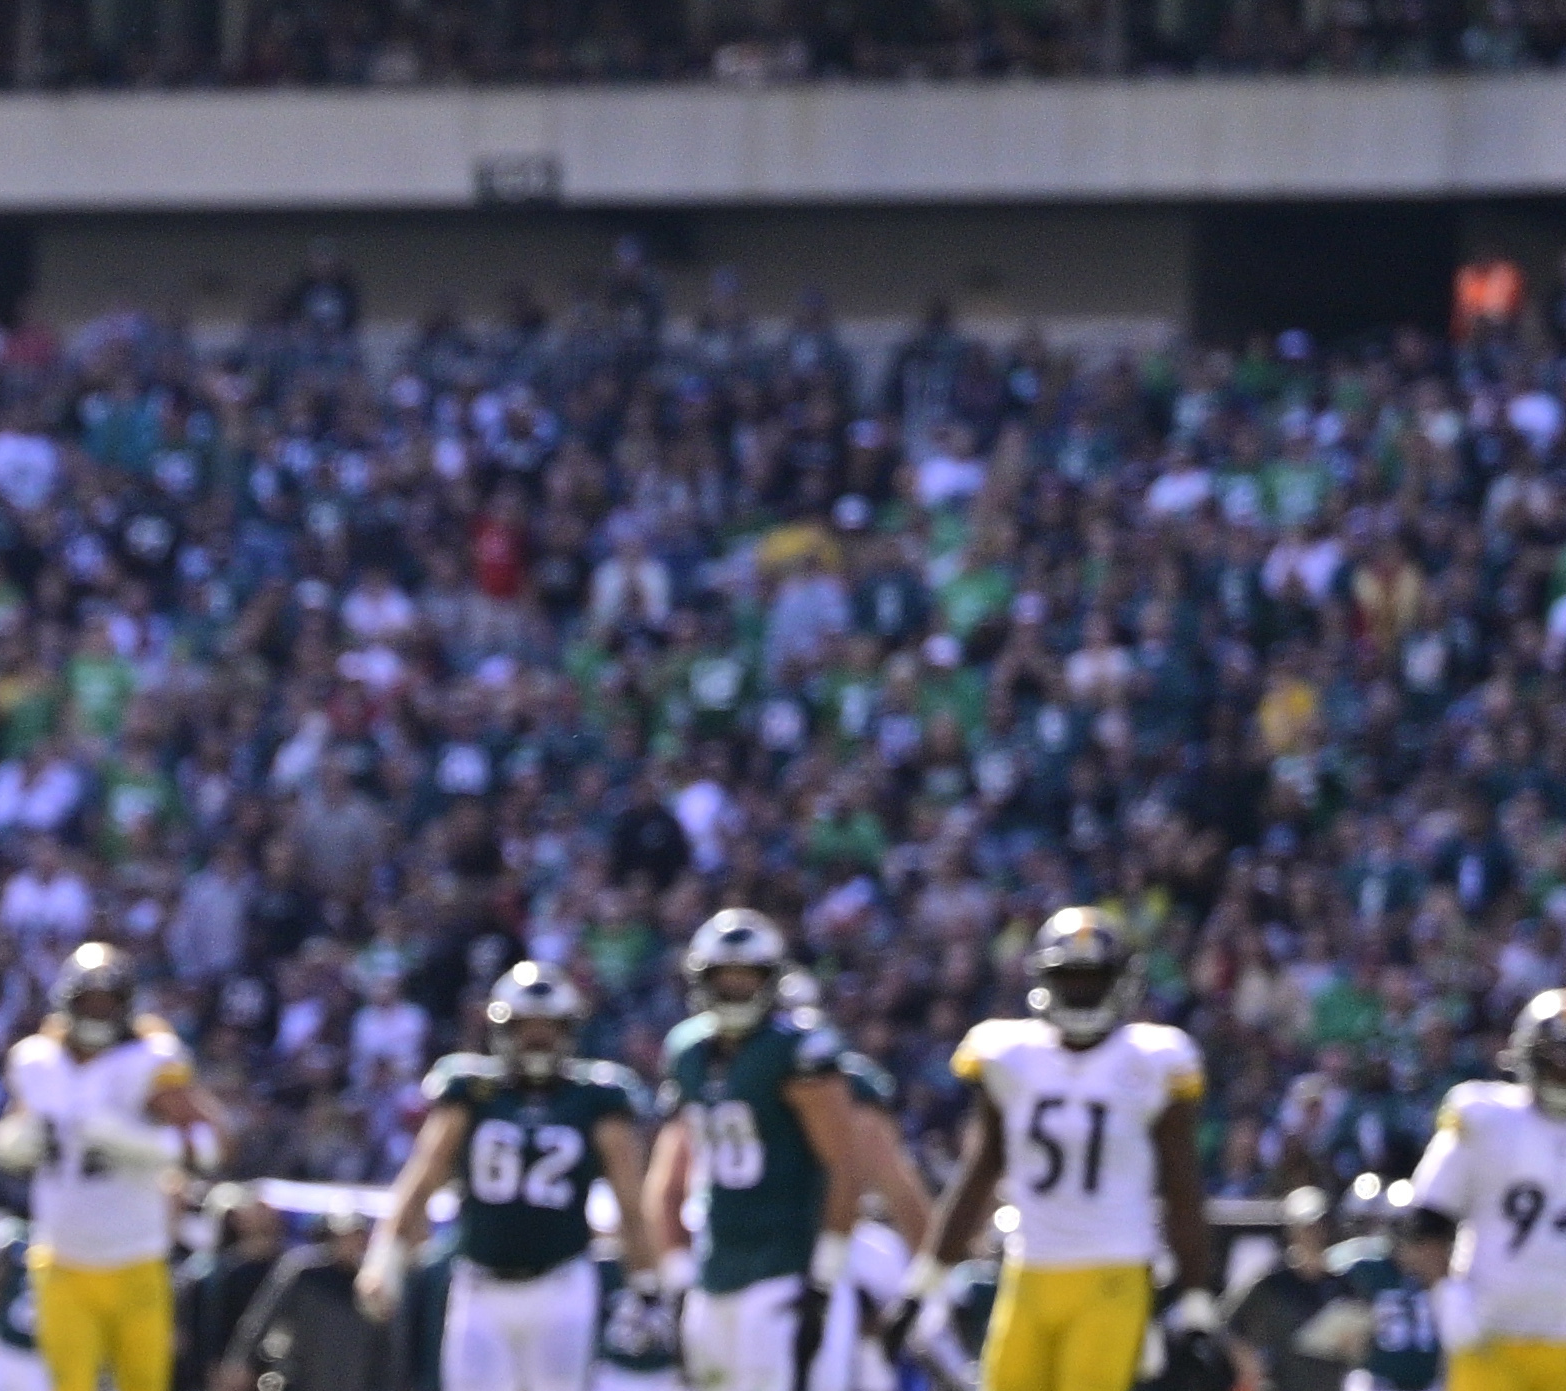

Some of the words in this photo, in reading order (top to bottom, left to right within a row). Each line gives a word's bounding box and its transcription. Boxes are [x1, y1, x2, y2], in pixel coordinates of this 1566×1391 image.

[470, 1118, 584, 1210] 62
[1028, 1095, 1109, 1195] 51
[1501, 1179, 1566, 1257] 9
